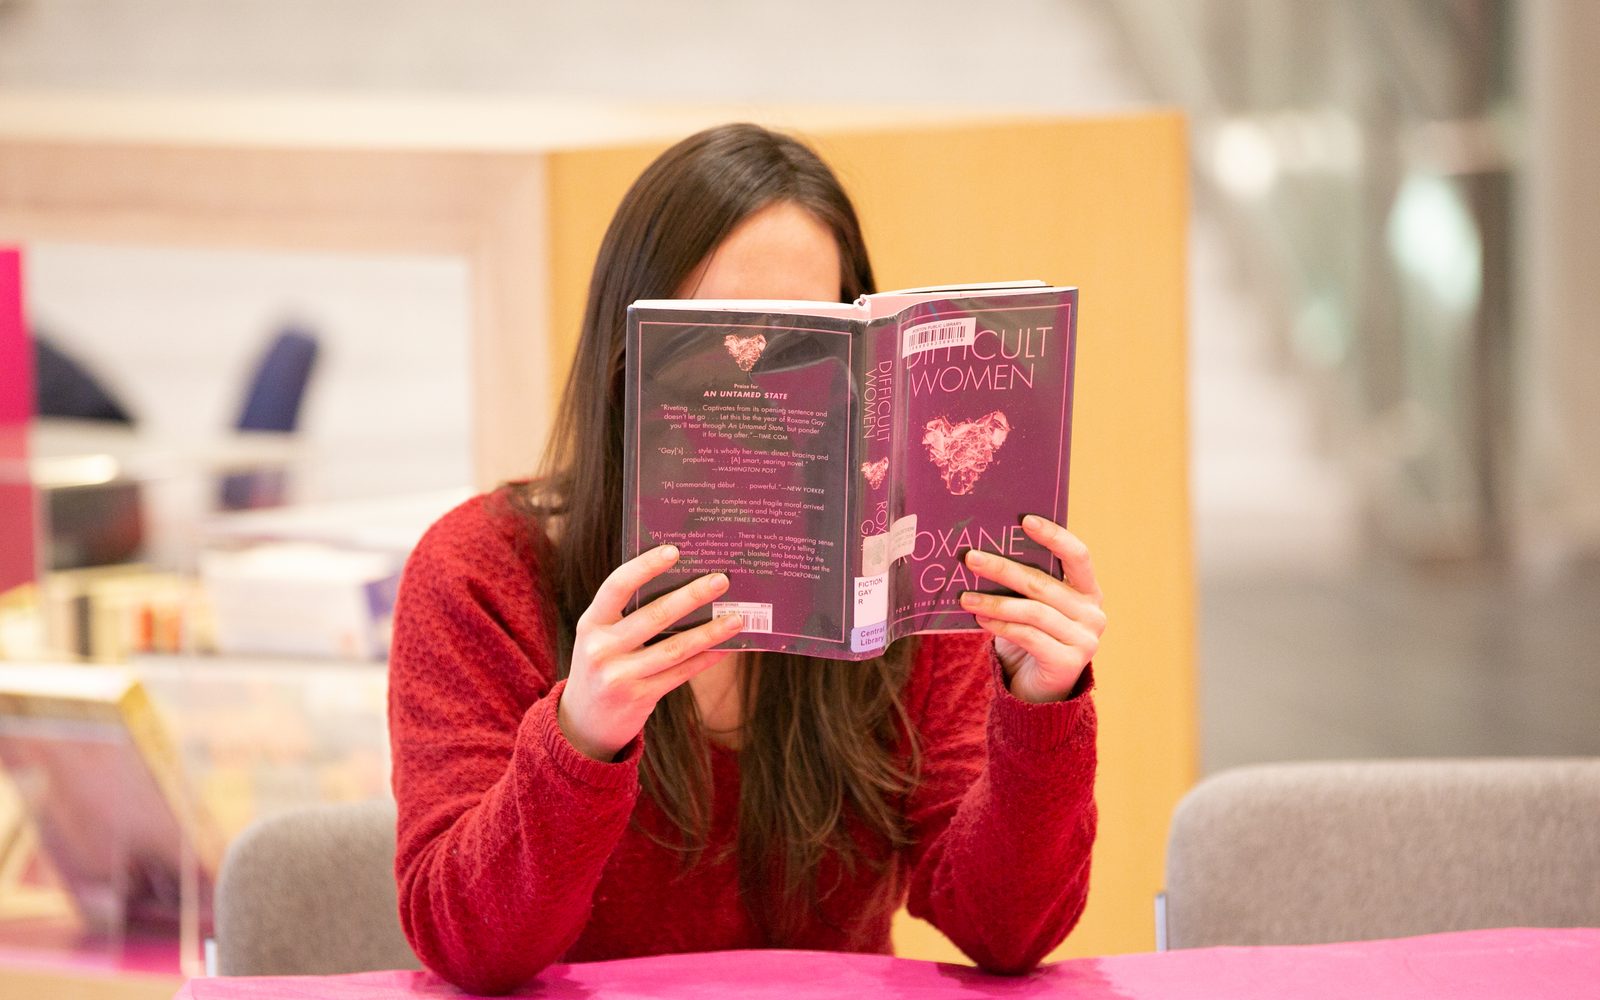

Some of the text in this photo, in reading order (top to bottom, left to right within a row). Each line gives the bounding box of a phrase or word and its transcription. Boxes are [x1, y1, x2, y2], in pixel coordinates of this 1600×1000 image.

[911, 363, 1034, 398] WOMEN
[719, 391, 761, 399] UNTAMED
[764, 392, 788, 400] STATE
[877, 360, 893, 442] DIFFICULT
[863, 367, 877, 439] WOMEN
[702, 404, 735, 412] Captivates
[761, 407, 786, 415] opening
[702, 422, 726, 430] through
[768, 424, 785, 432] State,
[718, 431, 732, 439] long
[771, 449, 790, 457] direct,
[792, 451, 815, 460] bracing
[763, 459, 786, 467] searing
[675, 481, 716, 489] commanding
[671, 497, 685, 505] fairy
[763, 498, 782, 507] fragile
[769, 508, 783, 516] high
[876, 501, 888, 535] ROX
[663, 531, 686, 539] riveting
[785, 536, 817, 545] staggering
[778, 543, 796, 551] Gay's
[797, 545, 816, 554] telling
[898, 525, 1025, 567] OXANE
[747, 549, 770, 557] blasted
[784, 553, 805, 561] beauty
[806, 554, 814, 562] by
[753, 560, 779, 568] gripping
[858, 577, 883, 588] FICTION
[858, 589, 873, 597] GAY
[914, 600, 935, 608] TIMES
[860, 626, 885, 638] Central
[860, 635, 884, 646] Library
